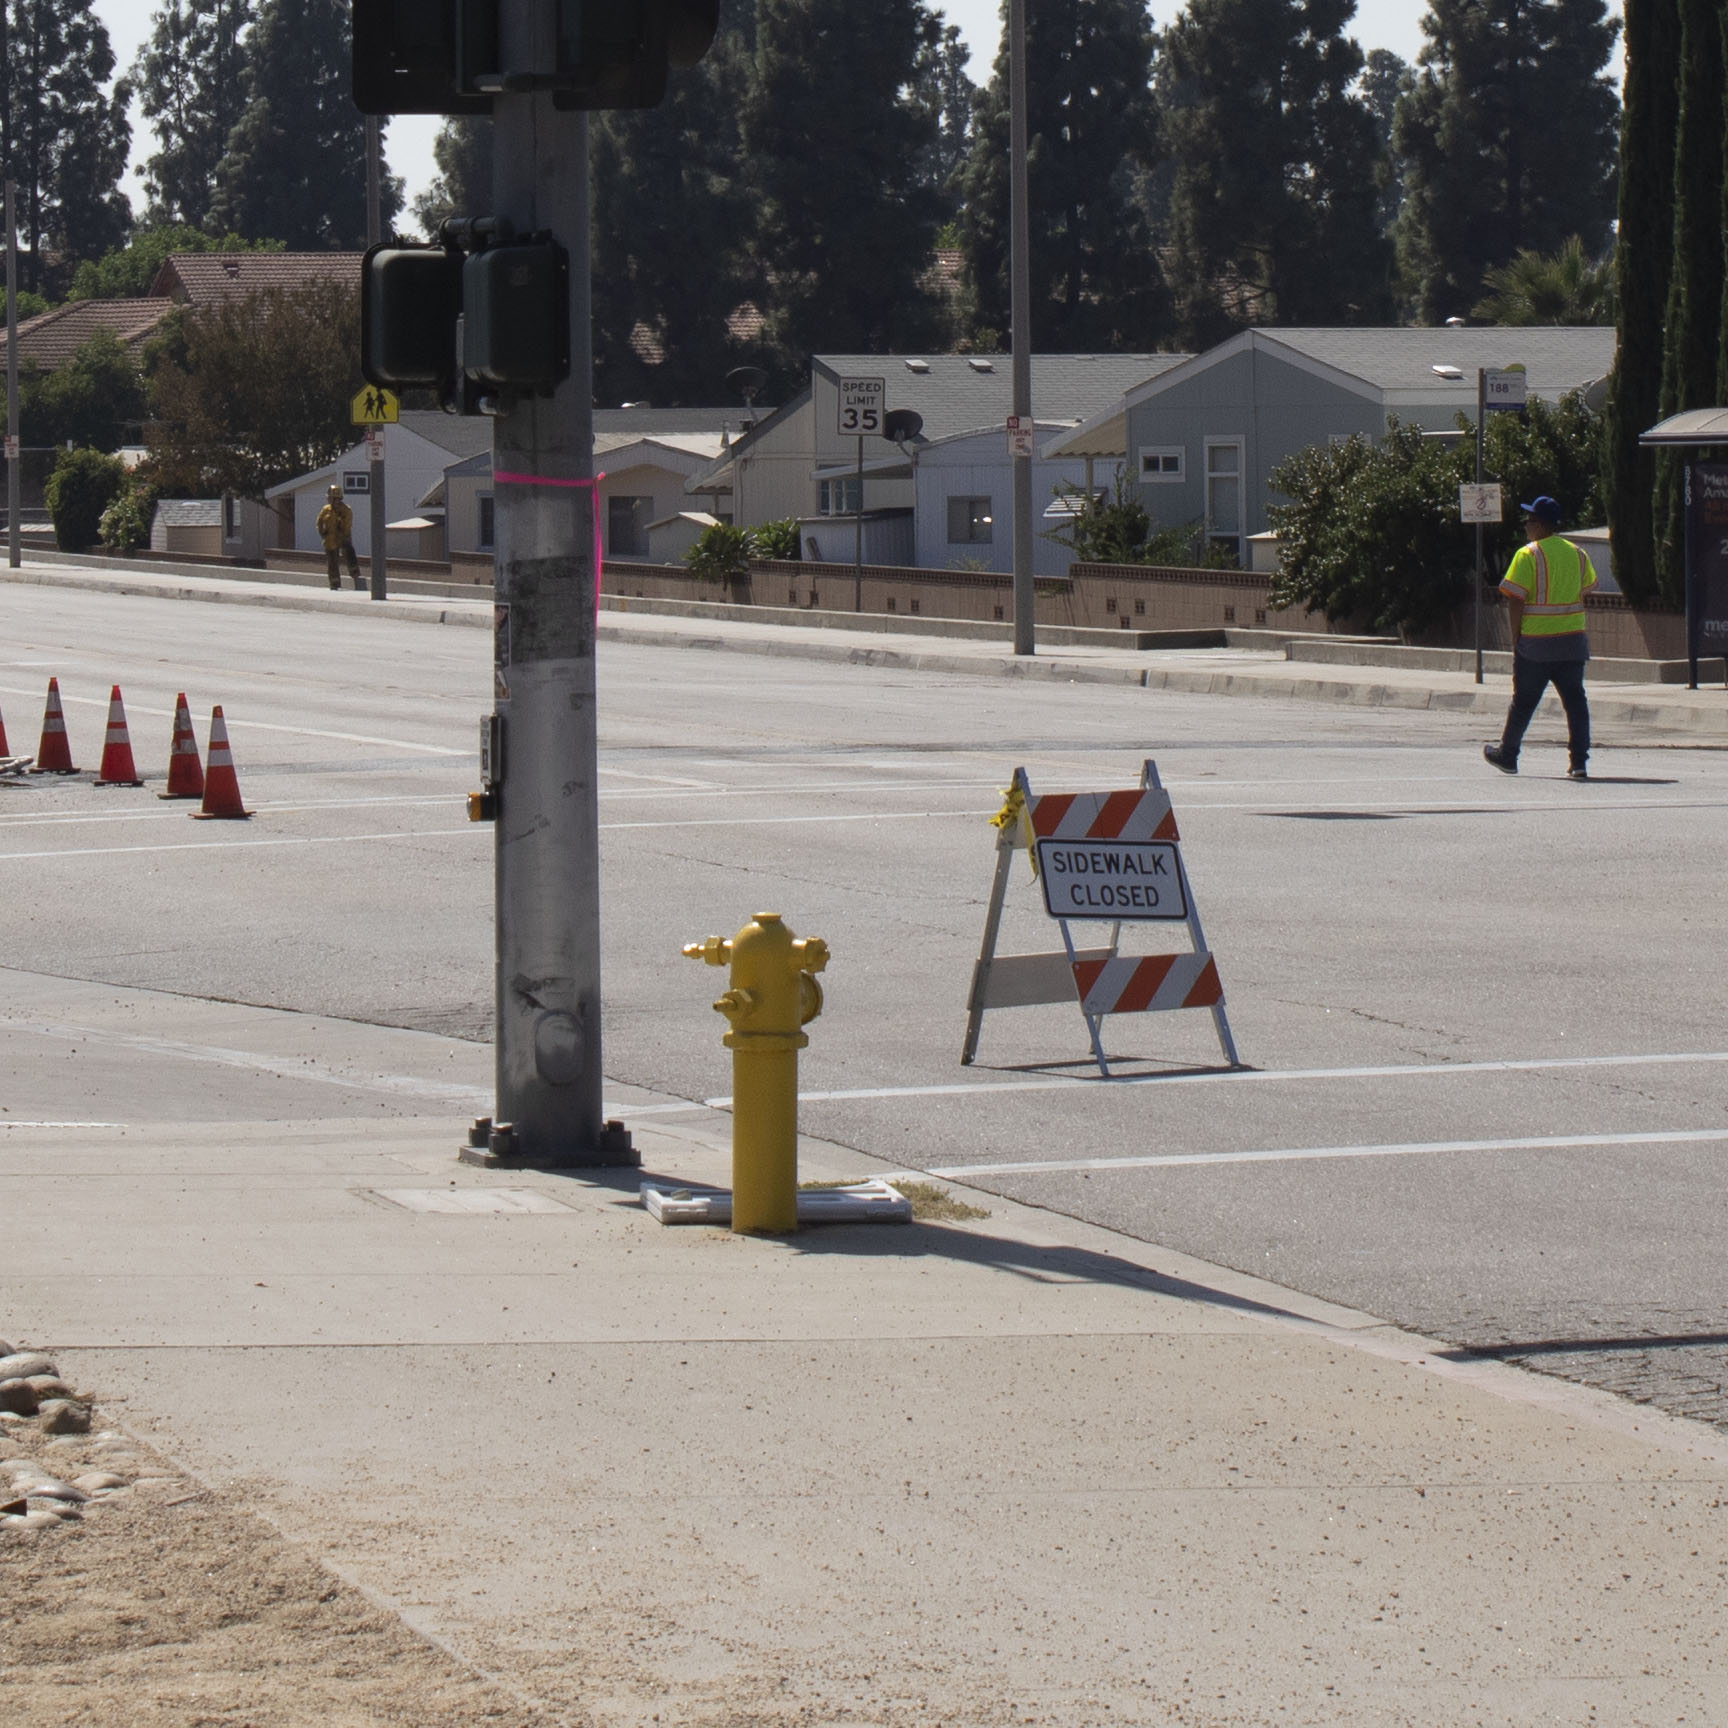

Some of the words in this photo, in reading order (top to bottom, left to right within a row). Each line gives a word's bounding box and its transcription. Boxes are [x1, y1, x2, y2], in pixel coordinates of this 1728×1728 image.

[842, 382, 881, 392] SPEED
[1490, 383, 1509, 393] 188
[846, 396, 876, 405] LIMIT
[842, 408, 878, 430] 35
[1053, 851, 1168, 875] SIDEWALK
[1070, 884, 1160, 907] CLOSED
